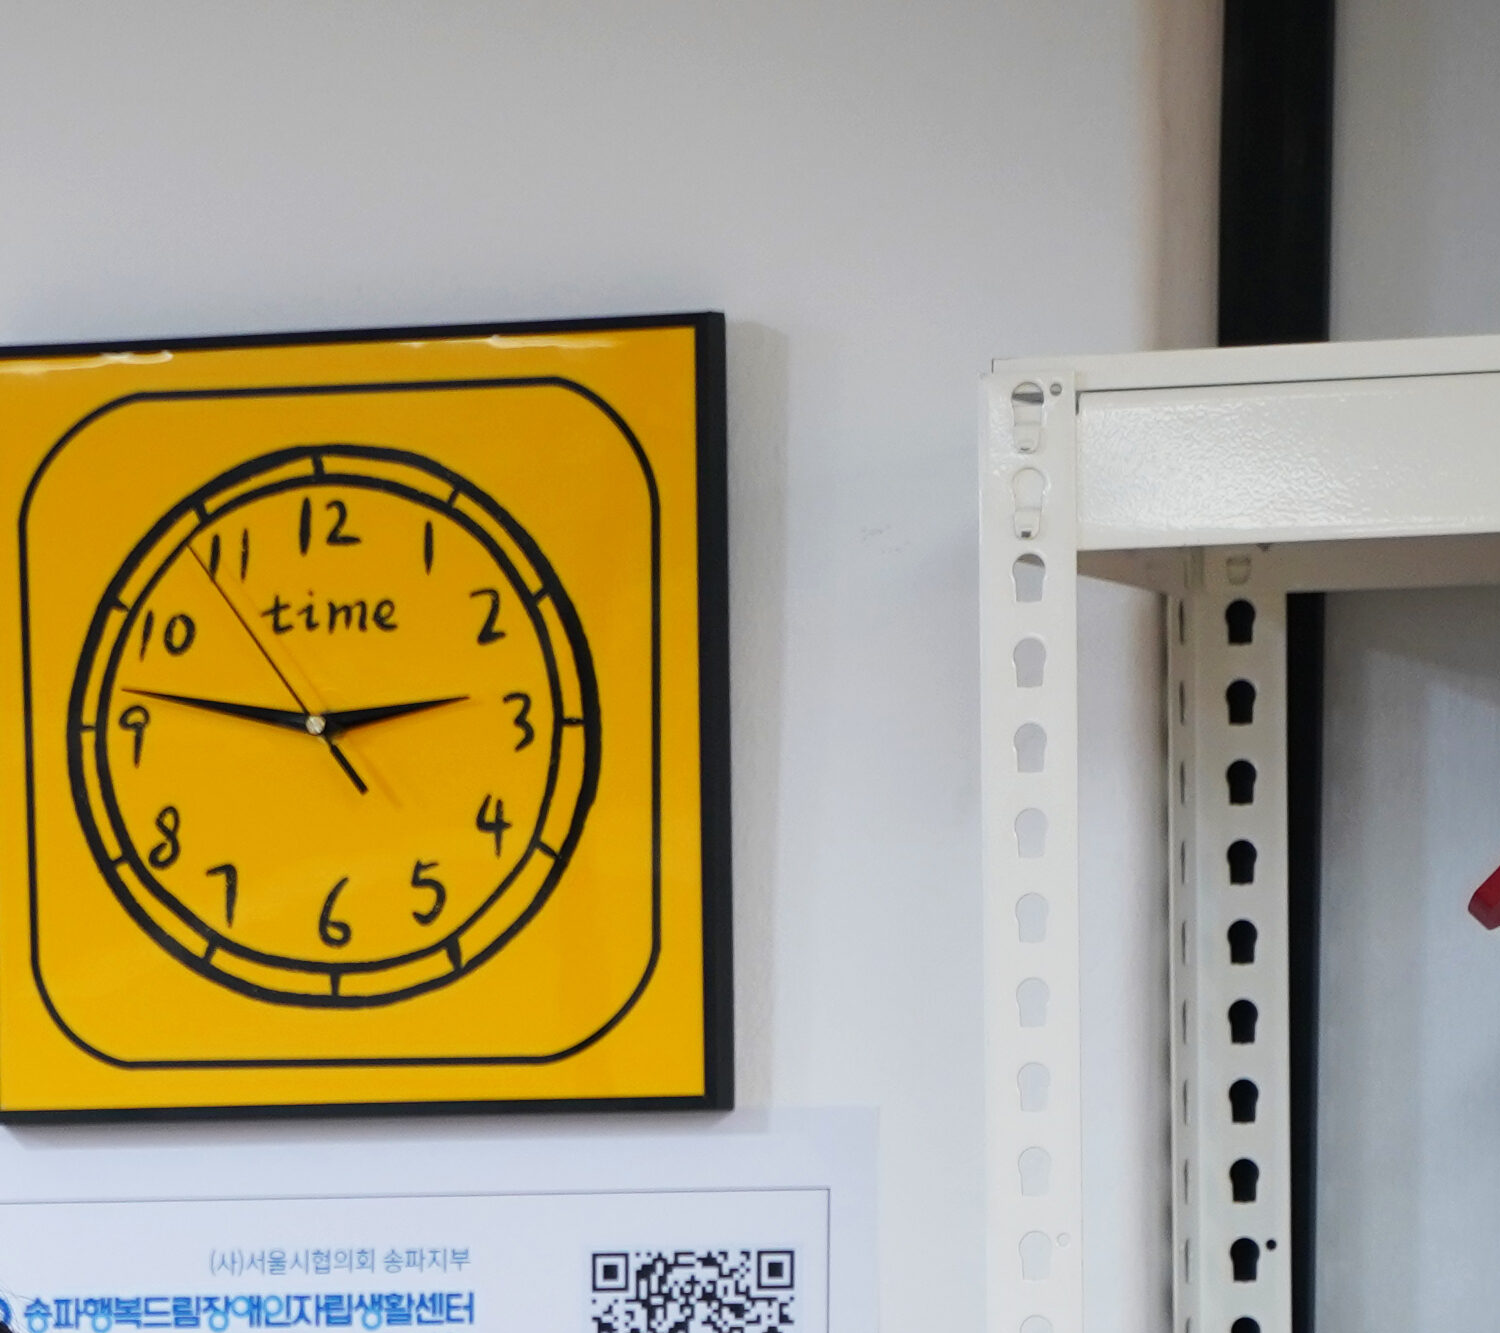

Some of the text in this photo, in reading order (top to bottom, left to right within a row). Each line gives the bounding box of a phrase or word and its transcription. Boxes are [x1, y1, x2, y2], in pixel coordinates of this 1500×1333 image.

[209, 528, 251, 582] 11
[299, 498, 361, 556] 12
[422, 520, 435, 574] 1
[138, 610, 196, 660] 10
[261, 592, 400, 635] time
[469, 589, 507, 645] 2
[119, 704, 150, 768] 9
[502, 694, 535, 752] 3
[148, 805, 182, 869] 8
[476, 795, 512, 857] 4
[207, 865, 239, 928] 7
[318, 877, 351, 947] 6
[411, 861, 448, 926] 5
[208, 1246, 472, 1276] (사)서울시협의회 송파지부
